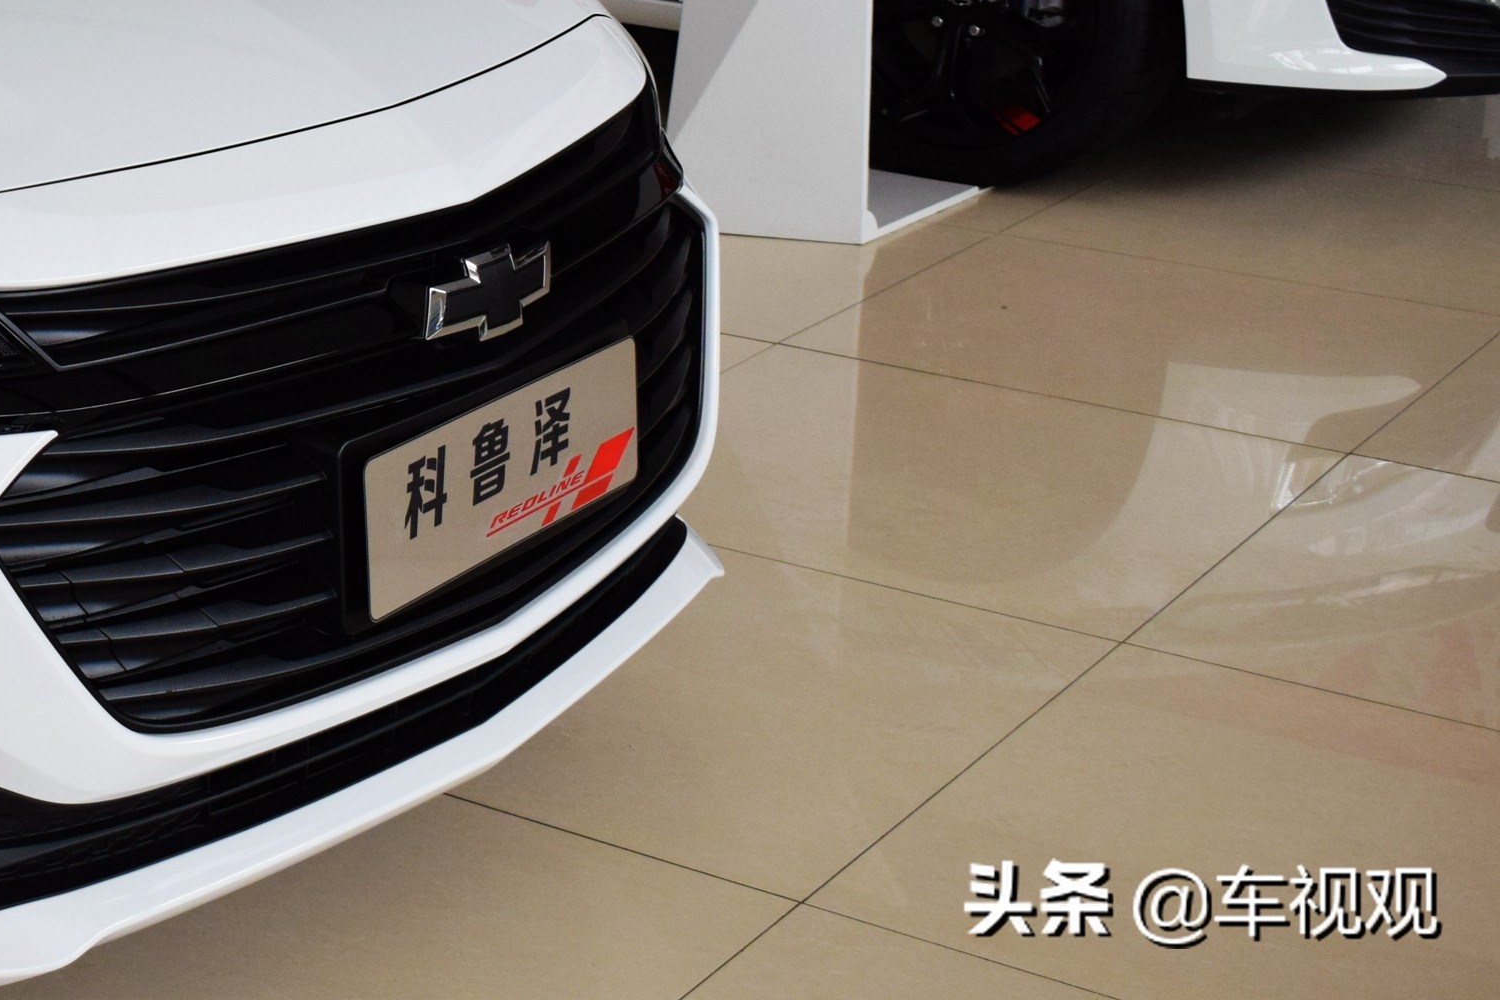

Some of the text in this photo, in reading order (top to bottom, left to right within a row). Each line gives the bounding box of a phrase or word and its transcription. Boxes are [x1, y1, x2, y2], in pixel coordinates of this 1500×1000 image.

[404, 386, 571, 540] 科鲁泽
[489, 470, 585, 529] REDLINE
